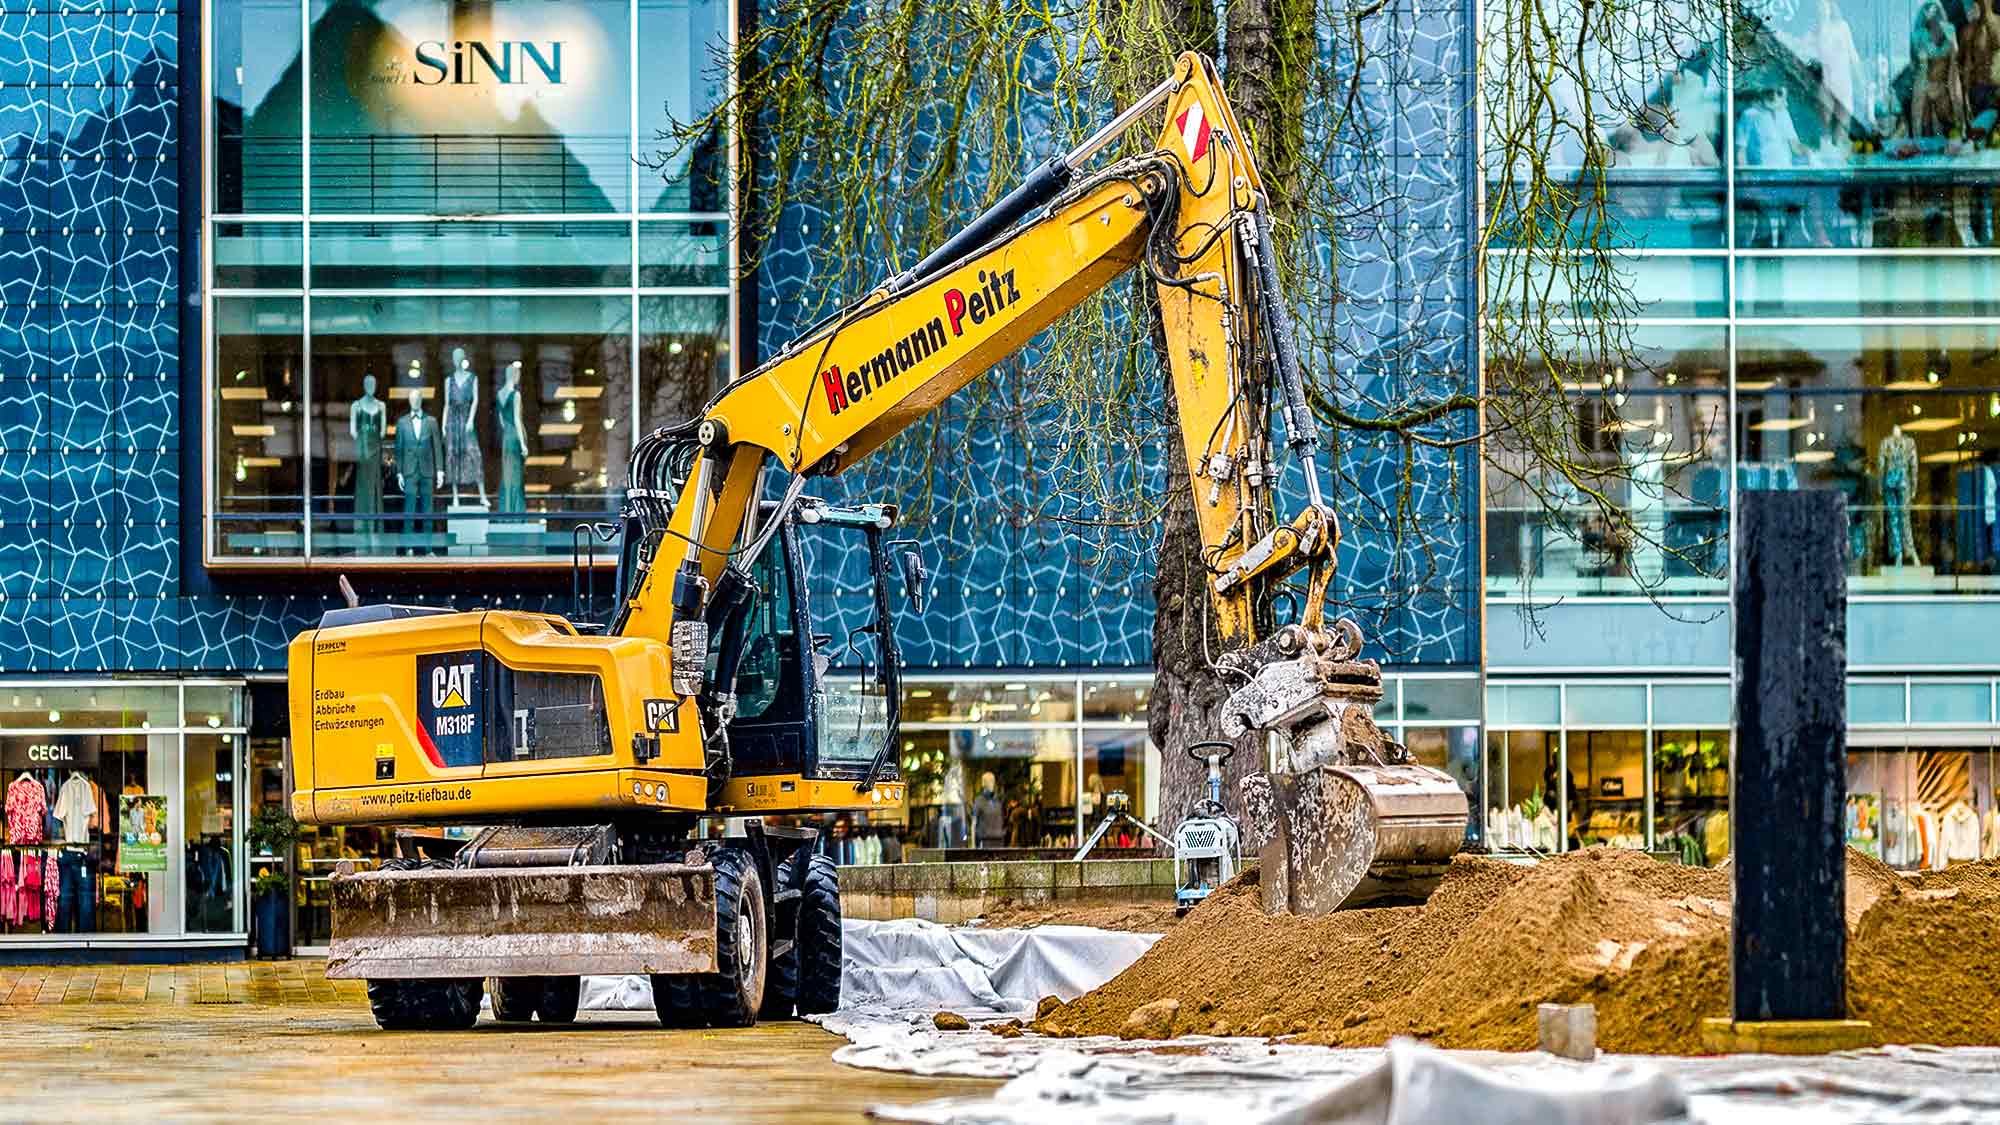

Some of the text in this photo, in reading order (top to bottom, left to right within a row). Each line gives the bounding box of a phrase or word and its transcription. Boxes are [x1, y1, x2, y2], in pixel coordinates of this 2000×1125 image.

[413, 40, 567, 85] SiNN
[821, 268, 1021, 416] Hermann Peitz
[315, 690, 345, 700] Erdbau
[432, 664, 474, 709] CAT
[315, 703, 356, 715] Abbrüche
[647, 702, 675, 730] CAT
[315, 717, 385, 731] Entwässerungen
[436, 714, 475, 736] M318F
[28, 745, 73, 761] CECIL
[361, 786, 472, 806] www.peitz-tiefbau.de
